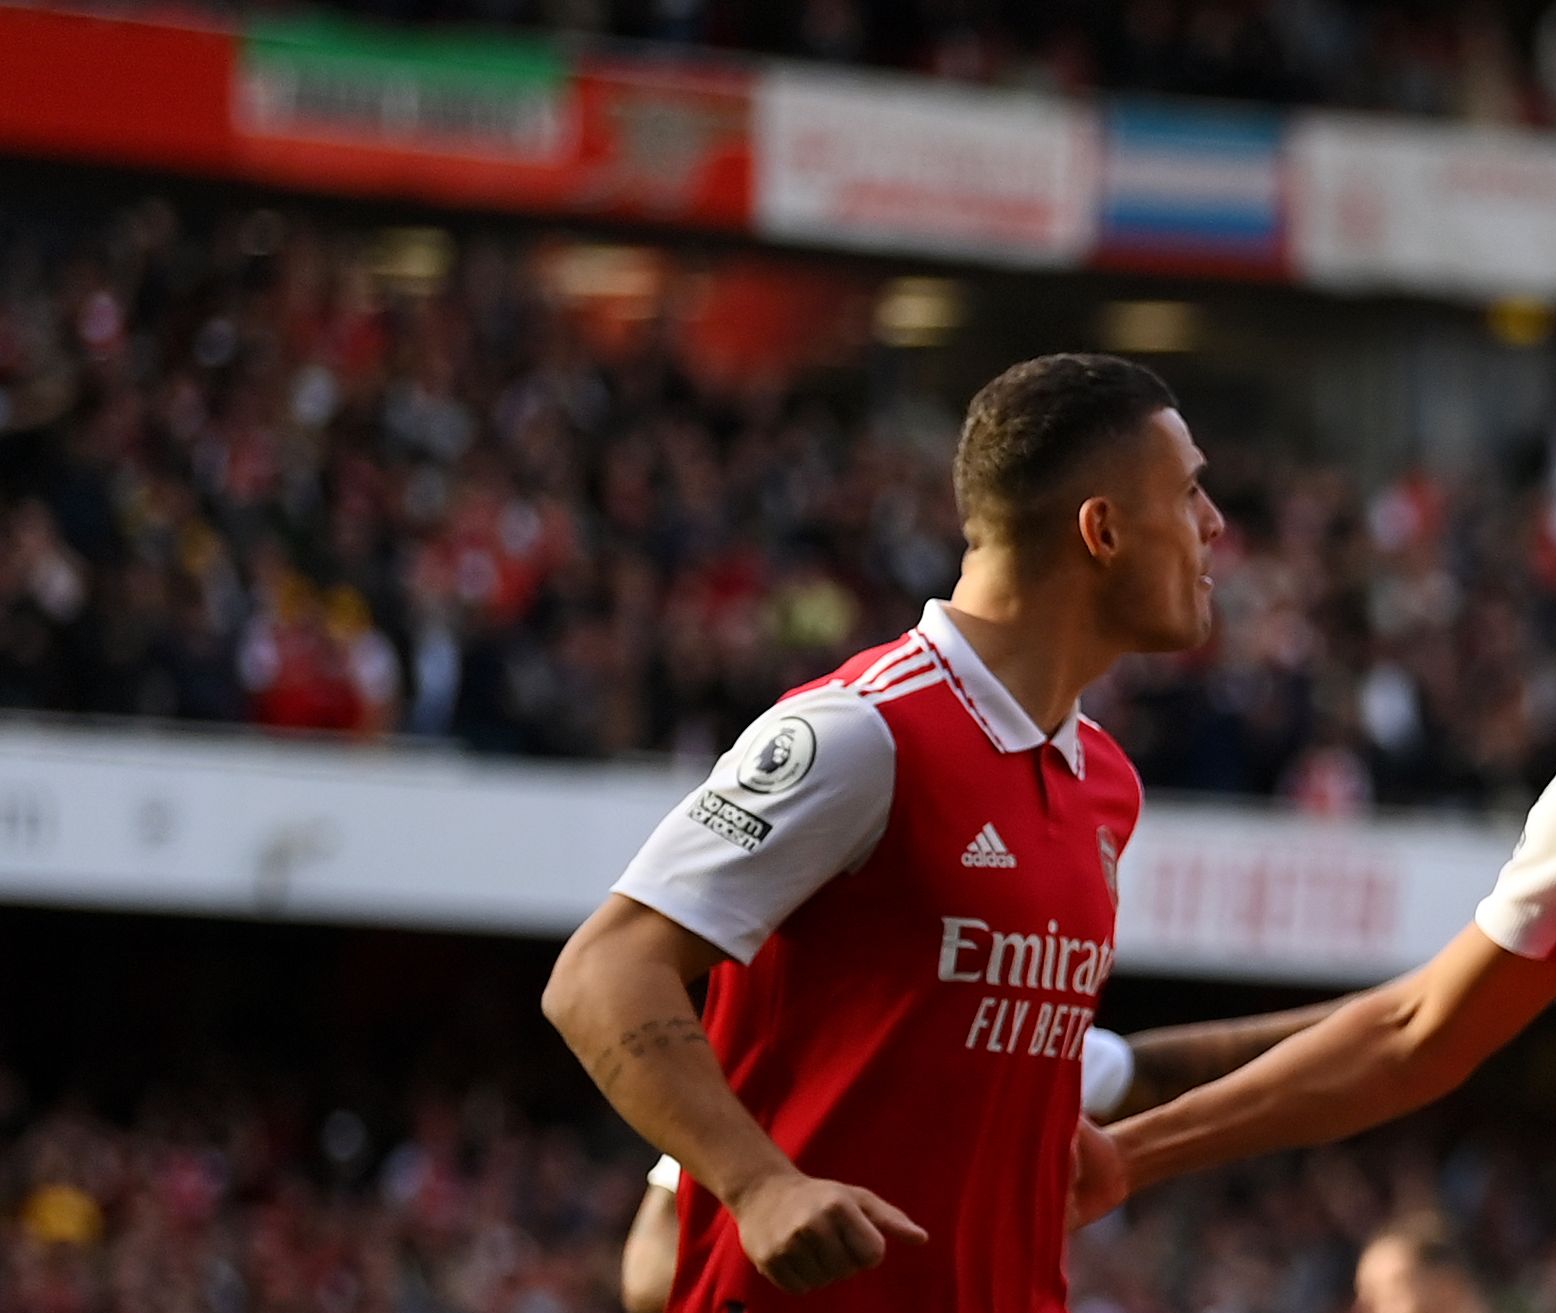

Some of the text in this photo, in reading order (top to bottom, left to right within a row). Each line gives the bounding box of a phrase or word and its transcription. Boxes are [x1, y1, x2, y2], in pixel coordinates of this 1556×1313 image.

[961, 851, 1017, 869] adidas
[938, 916, 1116, 997] Emirat
[965, 997, 1094, 1062] FLY BETT
